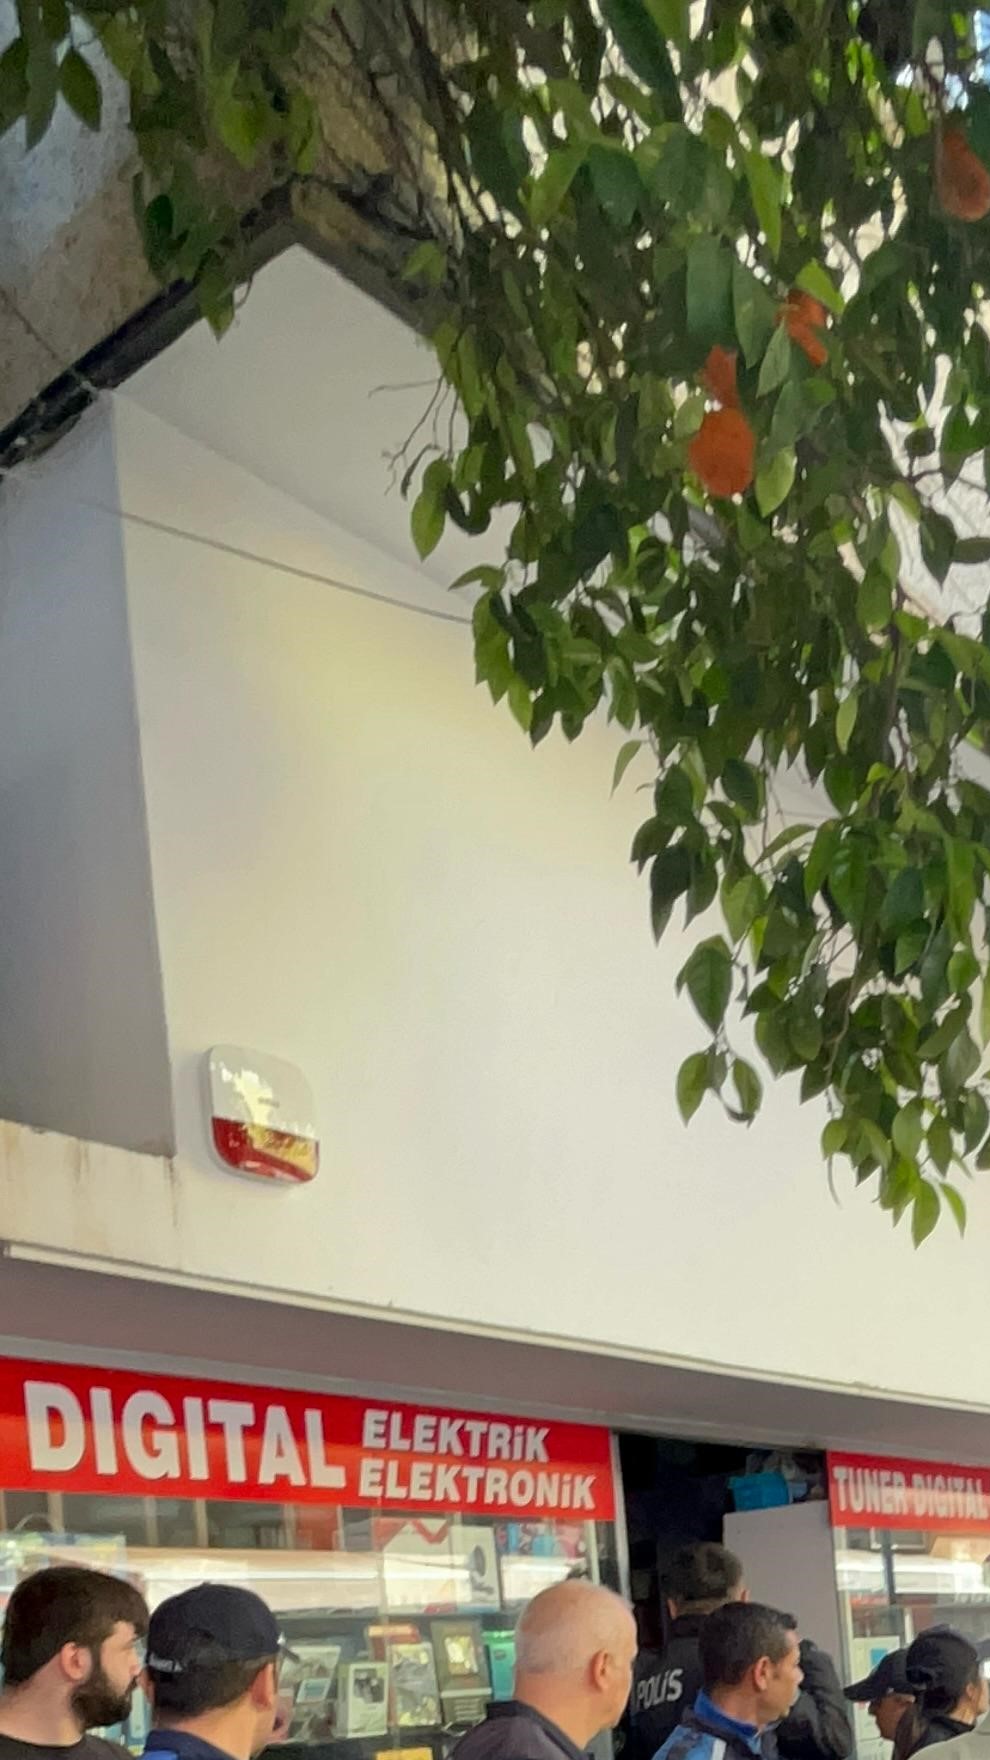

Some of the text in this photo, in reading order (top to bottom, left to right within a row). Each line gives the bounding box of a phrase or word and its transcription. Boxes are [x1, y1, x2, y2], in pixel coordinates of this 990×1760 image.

[23, 1379, 347, 1489] DIGITAL
[833, 1466, 989, 1520] TUNER DIGITAL
